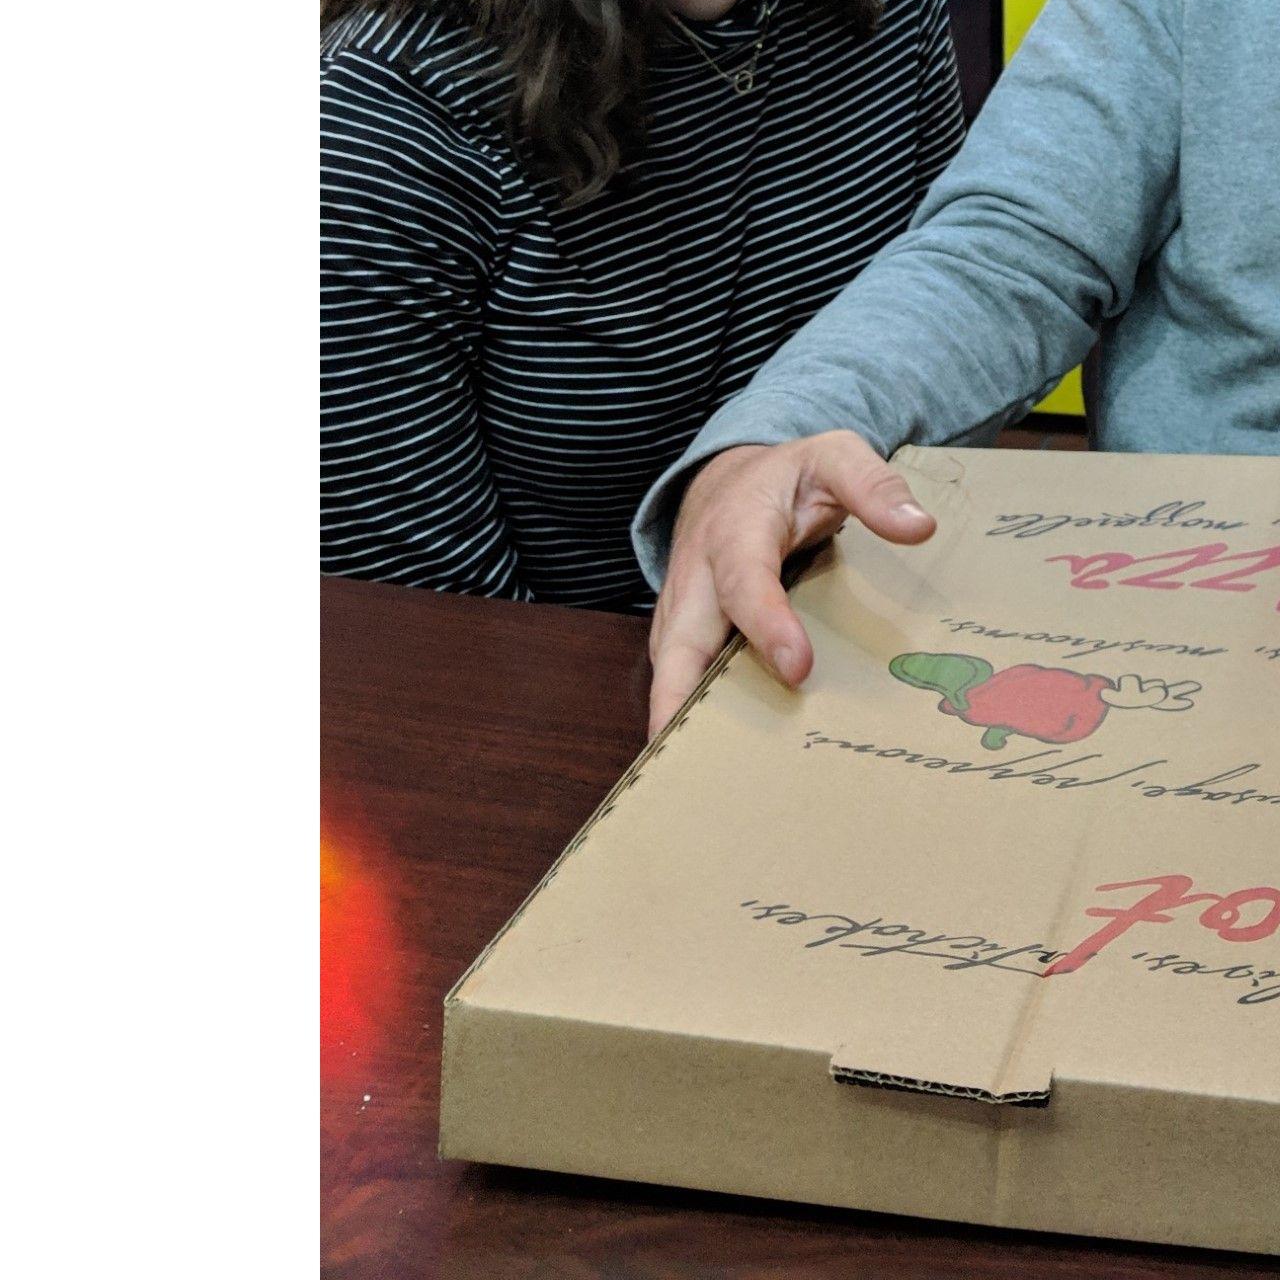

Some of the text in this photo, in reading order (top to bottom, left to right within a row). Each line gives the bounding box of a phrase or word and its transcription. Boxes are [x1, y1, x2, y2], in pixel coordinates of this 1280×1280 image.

[986, 501, 1248, 539] mozzarella
[940, 617, 1229, 659] mushrooms,
[804, 730, 1168, 790] pepperoni,
[740, 900, 1096, 979] rtichokes,
